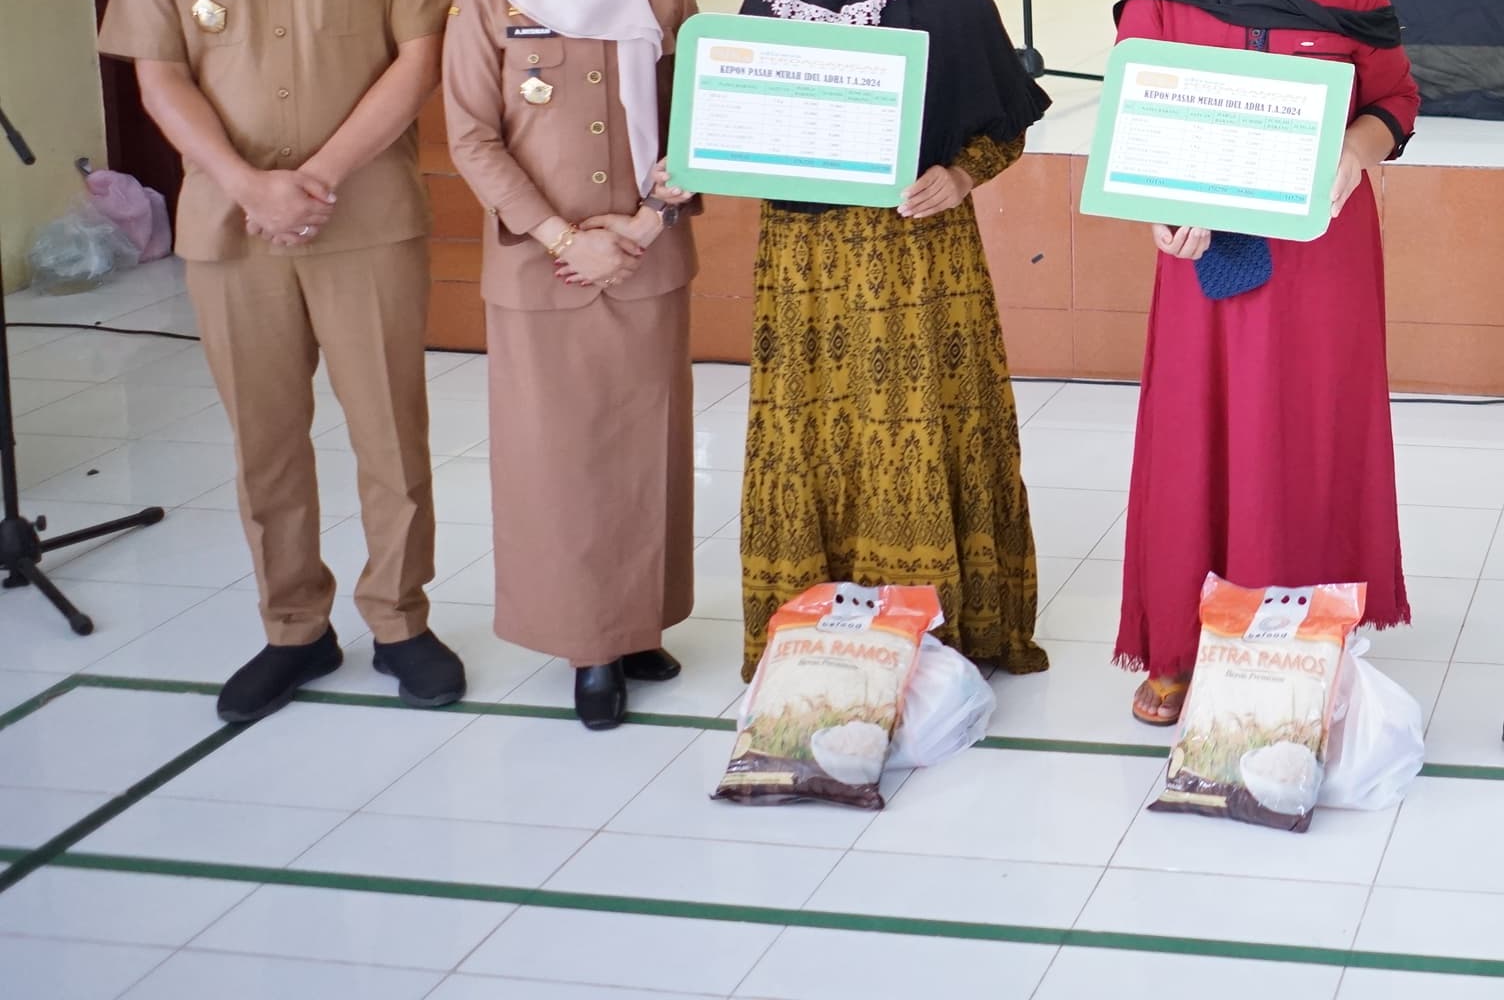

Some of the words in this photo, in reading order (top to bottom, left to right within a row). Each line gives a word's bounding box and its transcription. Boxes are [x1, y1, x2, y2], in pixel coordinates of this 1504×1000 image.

[1171, 92, 1196, 104] PASAR
[1244, 101, 1265, 112] ADHA
[777, 640, 824, 657] SETRA
[829, 640, 900, 668] RAMOS
[1198, 646, 1250, 664] SETRA
[1257, 650, 1327, 676] RAMOS
